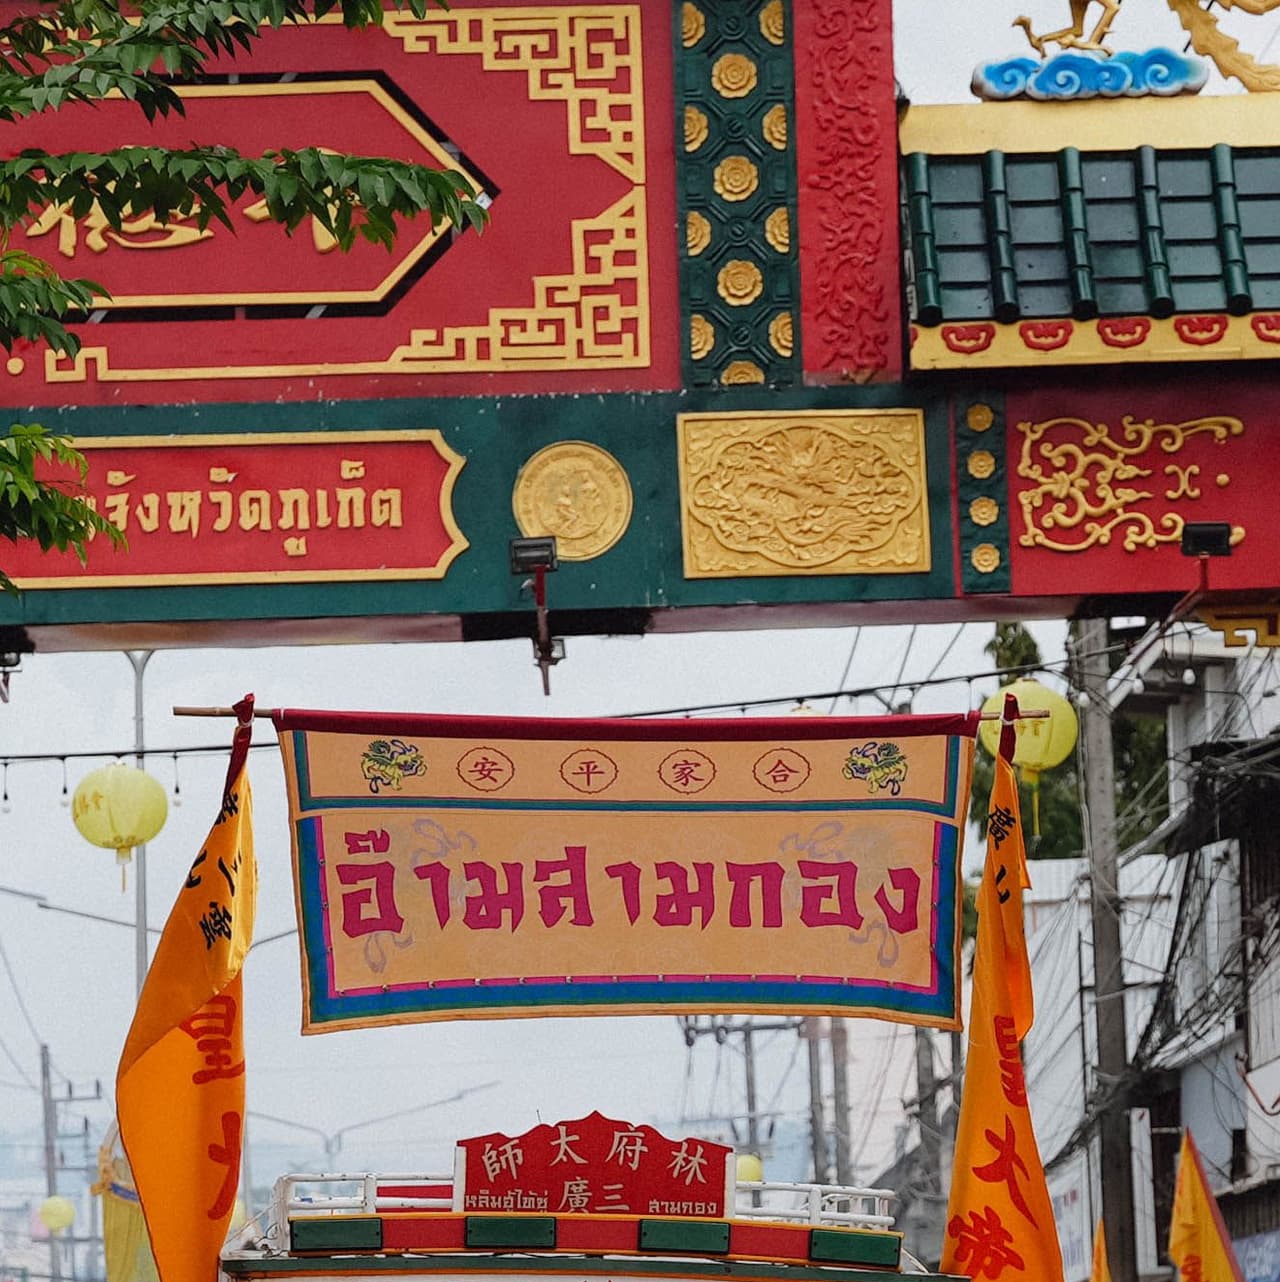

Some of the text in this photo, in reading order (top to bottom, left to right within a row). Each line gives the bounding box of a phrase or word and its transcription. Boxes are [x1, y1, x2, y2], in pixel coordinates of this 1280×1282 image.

[335, 827, 924, 938] อ๊ามสามกอง
[648, 1199, 718, 1215] สามกอง
